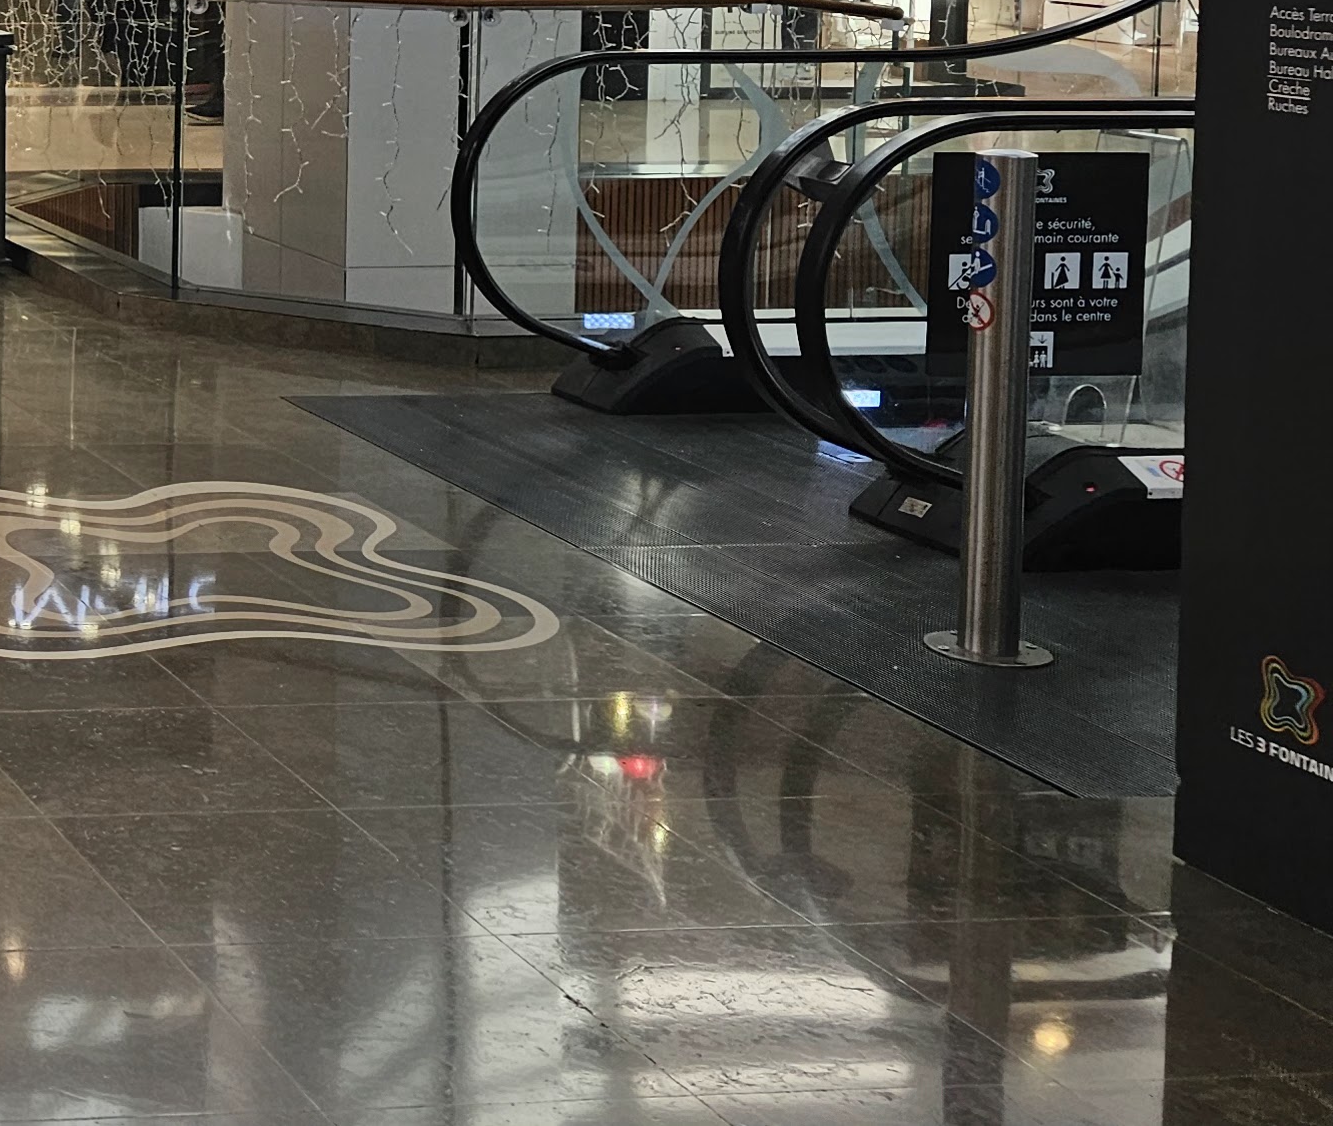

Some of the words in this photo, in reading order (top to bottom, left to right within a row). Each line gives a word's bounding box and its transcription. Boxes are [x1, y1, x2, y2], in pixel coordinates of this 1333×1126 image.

[1269, 5, 1305, 21] Accès
[1269, 23, 1333, 41] Boulodrom
[1269, 41, 1318, 59] Bureaux
[1269, 60, 1310, 77] Bureau
[1268, 78, 1311, 96] Crèche
[1267, 96, 1310, 115] Ruches
[1034, 196, 1068, 204] ONTAINES
[1047, 217, 1096, 231] sécurité,
[1067, 230, 1120, 244] courante
[1050, 295, 1074, 308] sont
[1078, 294, 1086, 307] à
[1089, 295, 1119, 307] votre
[1031, 308, 1058, 322] dans
[1061, 307, 1072, 322] le
[1075, 308, 1112, 322] centre
[1230, 725, 1254, 749] LES
[1255, 735, 1267, 753] 3
[1268, 741, 1333, 783] FONTAIN
